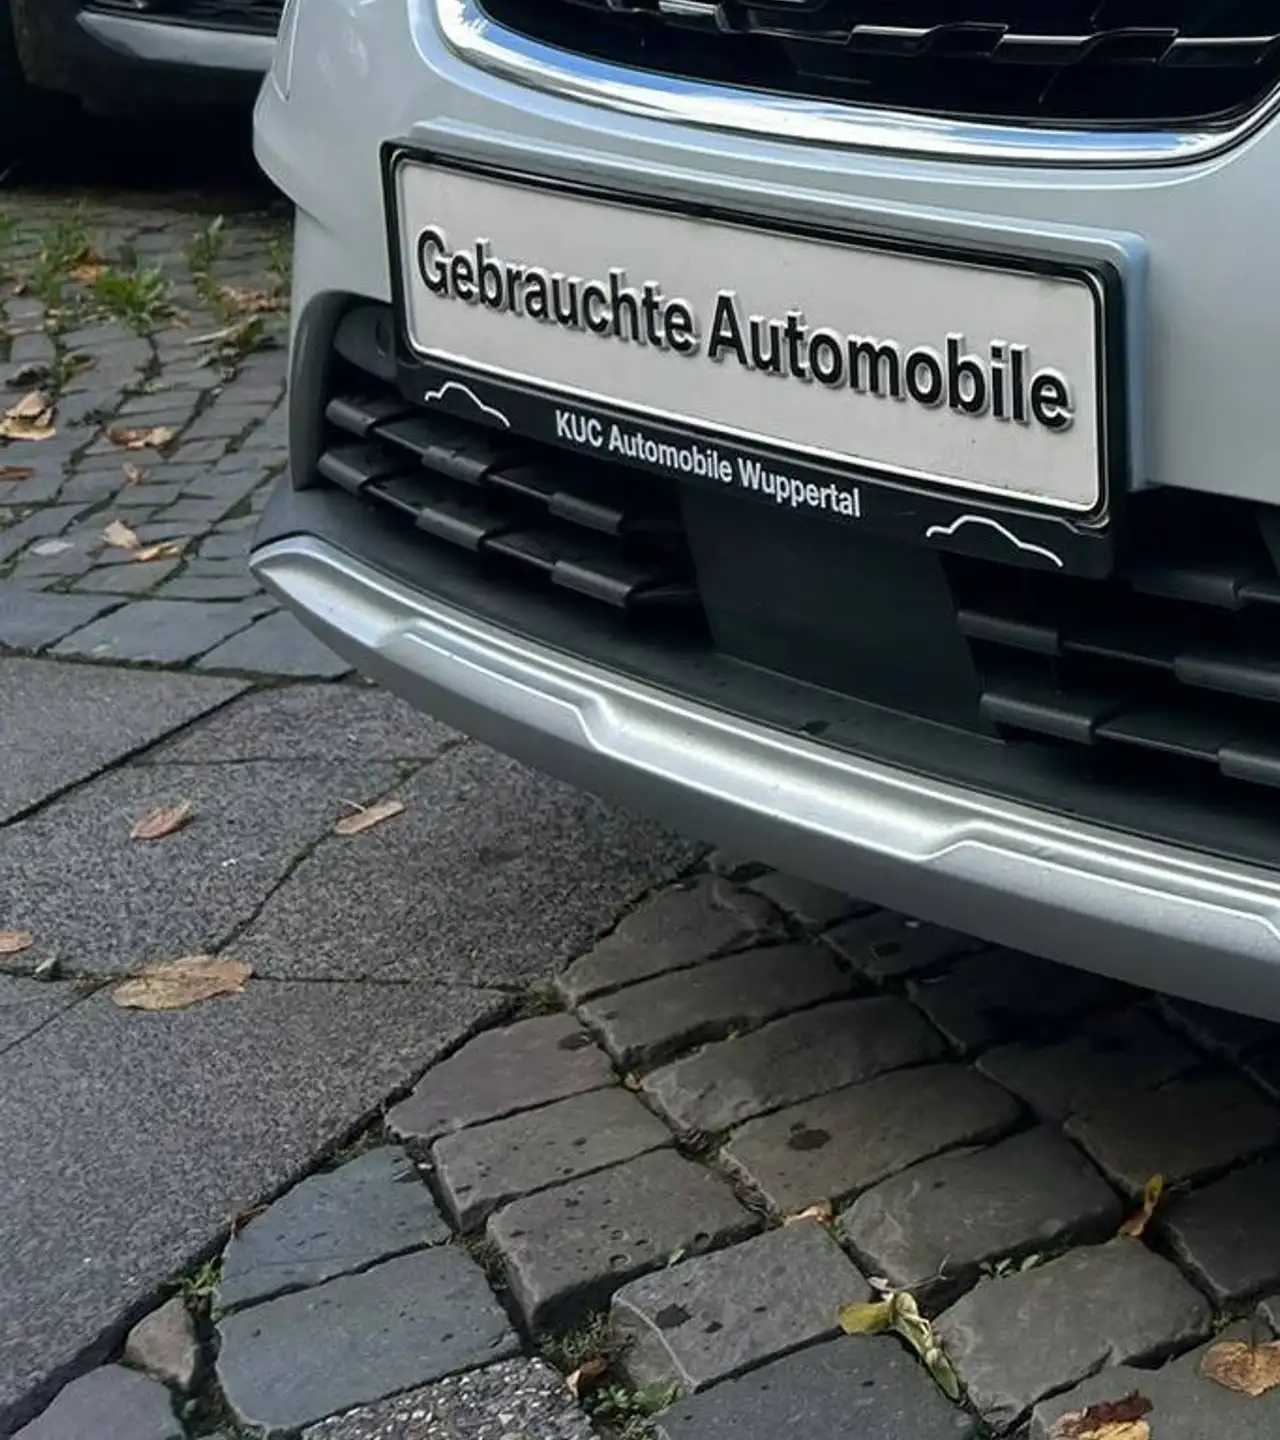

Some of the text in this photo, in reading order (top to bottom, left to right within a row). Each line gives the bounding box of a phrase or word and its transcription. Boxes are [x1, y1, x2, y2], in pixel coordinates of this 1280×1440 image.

[416, 225, 1072, 430] Gebrauchte Automobile
[556, 410, 861, 517] KUC Automobile Wuppertal
